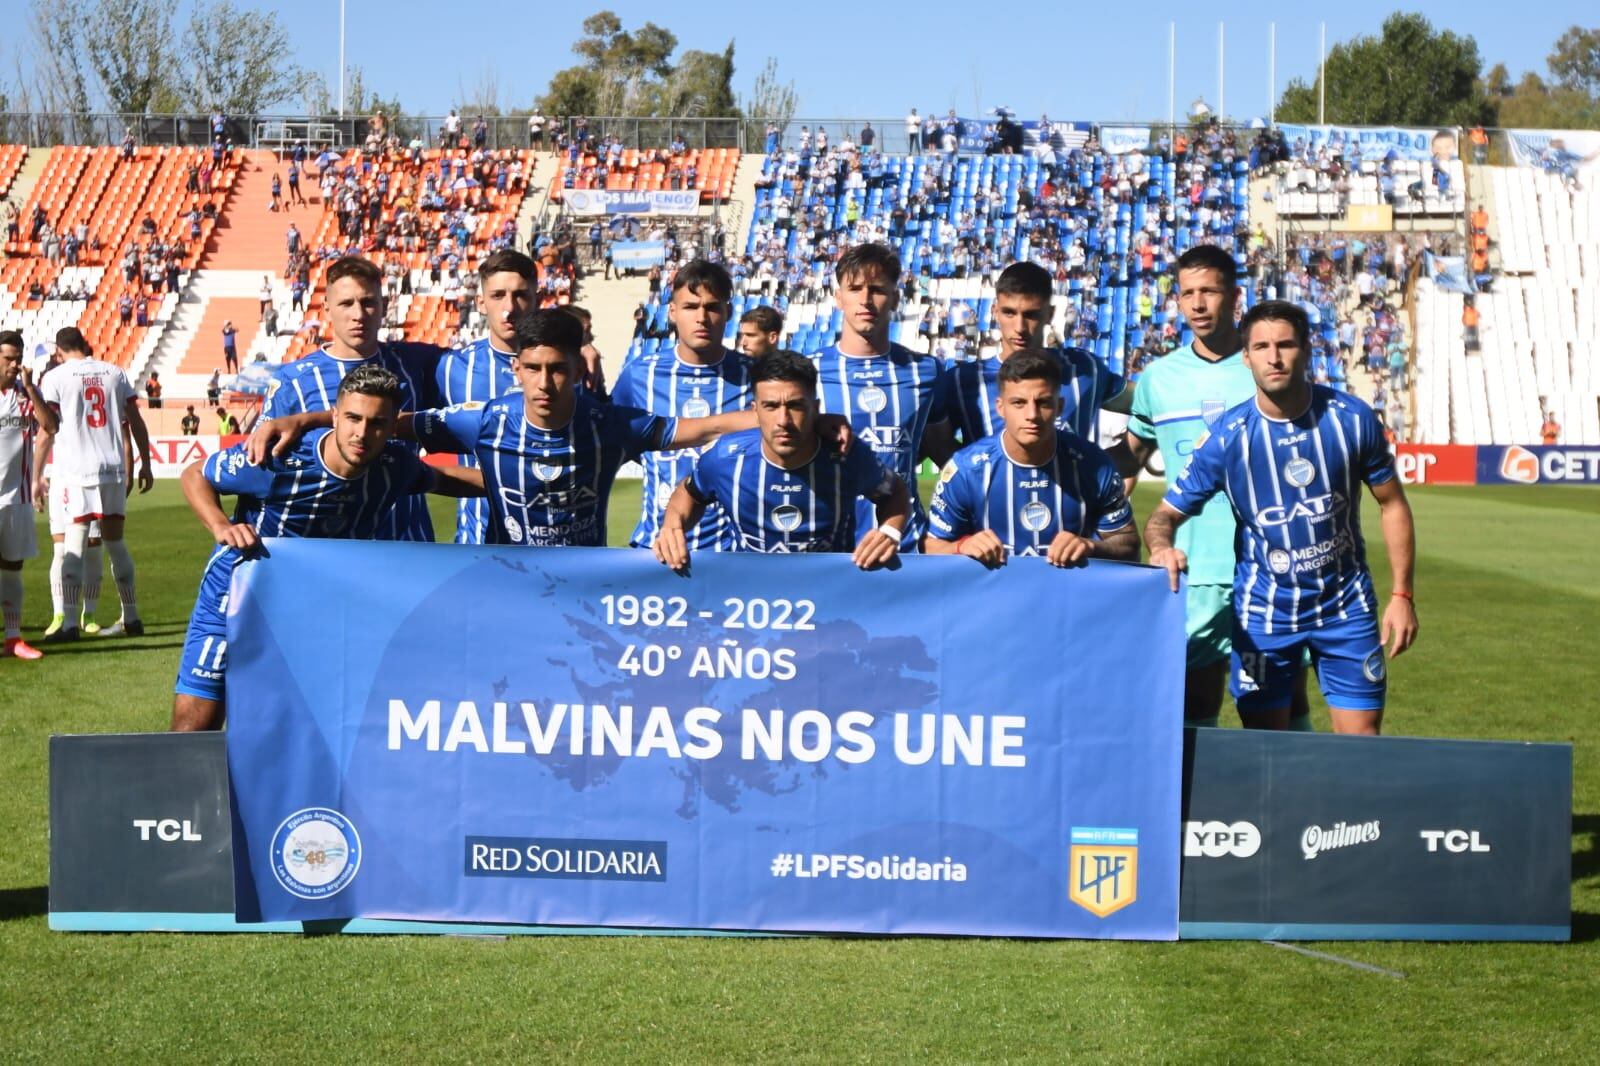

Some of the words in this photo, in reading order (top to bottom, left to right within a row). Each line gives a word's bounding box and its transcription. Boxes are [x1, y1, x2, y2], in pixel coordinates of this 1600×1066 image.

[82, 377, 104, 386] ROGEL
[85, 386, 107, 428] 3
[1257, 492, 1346, 526] CATA
[601, 595, 688, 628] 1982
[723, 598, 816, 631] 2022
[688, 639, 797, 681] AÑOS
[388, 699, 723, 760] MALVINAS
[741, 709, 876, 764] NOS
[894, 713, 1026, 767] UNE
[133, 819, 202, 841] TCL
[1193, 831, 1249, 847] YPF
[1302, 820, 1380, 860] Quilmes
[1420, 830, 1490, 852] TCL
[472, 844, 522, 872] RED
[770, 853, 967, 882] #LPFSolidaria
[1079, 855, 1128, 905] LPF
